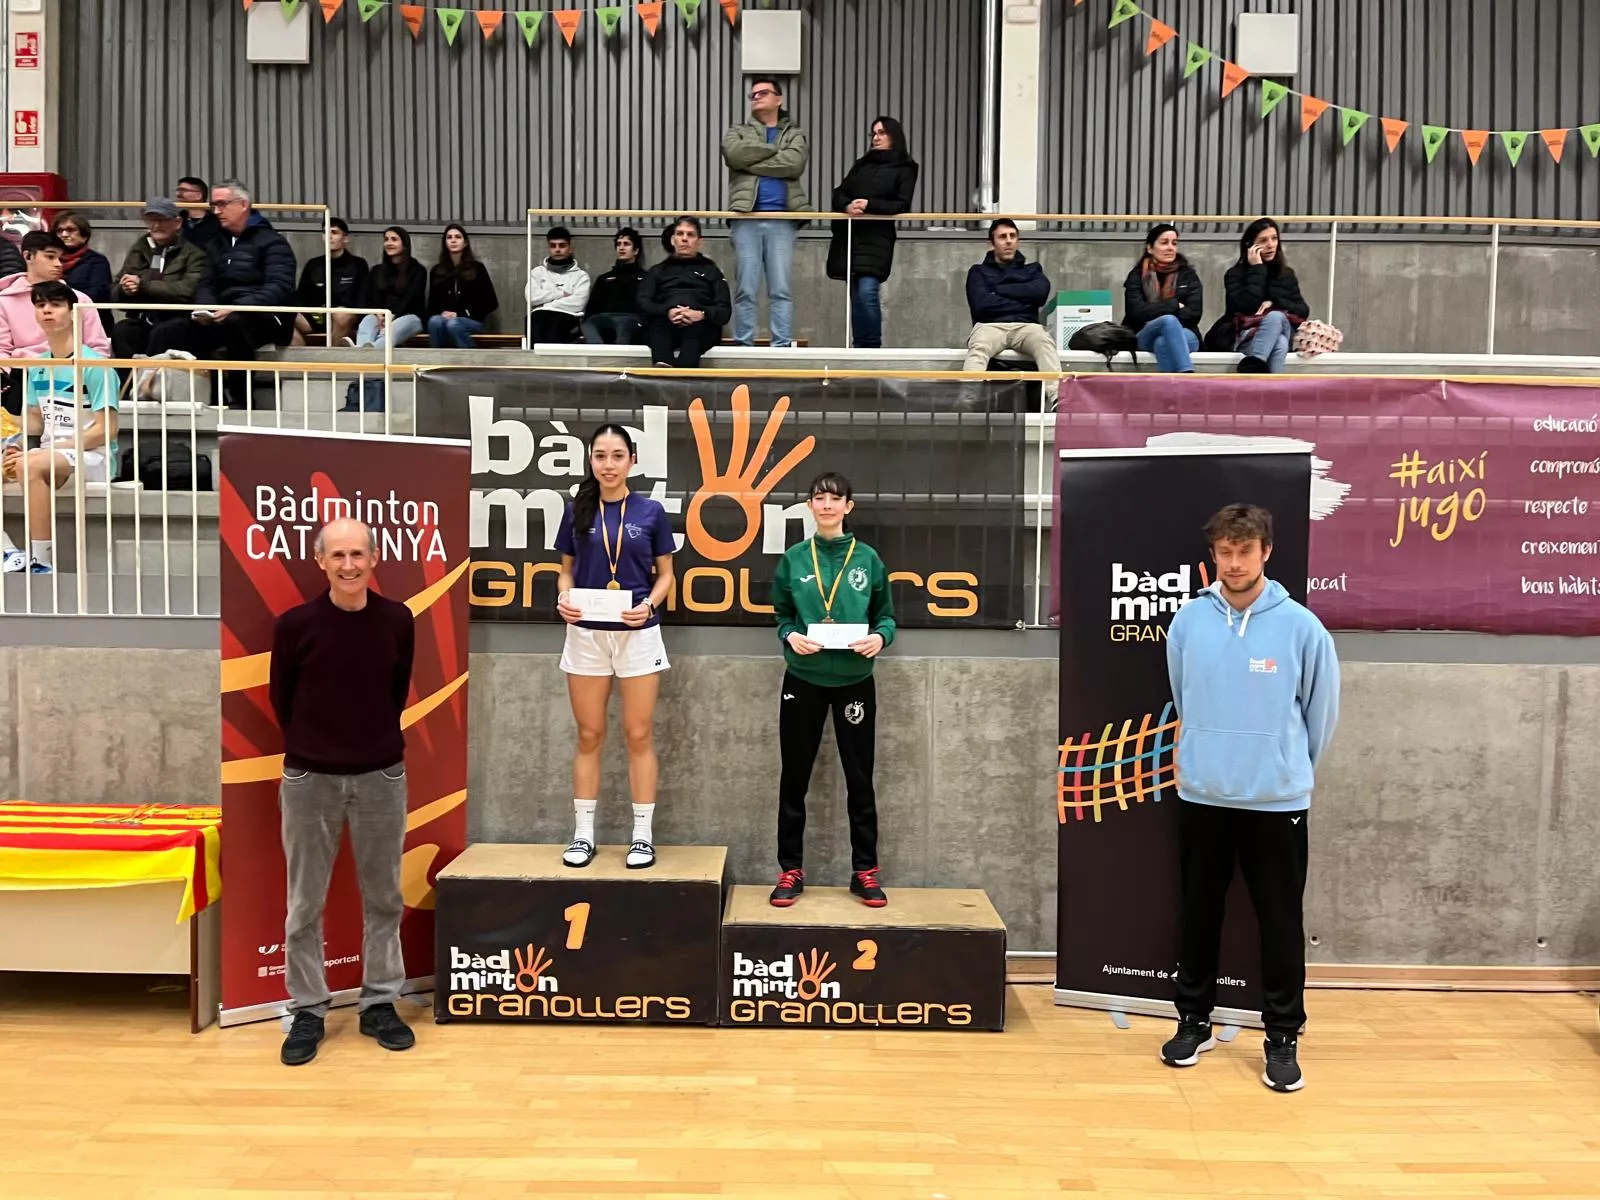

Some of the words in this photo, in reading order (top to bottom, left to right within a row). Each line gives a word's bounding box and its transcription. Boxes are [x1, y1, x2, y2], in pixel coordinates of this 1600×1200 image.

[468, 394, 668, 479] bàd
[1533, 413, 1598, 433] educació
[1388, 449, 1488, 489] #així
[255, 485, 439, 526] Bàdminton
[1389, 487, 1486, 548] jugo
[1524, 496, 1588, 520] respecte
[1111, 562, 1191, 593] bàd
[1521, 575, 1555, 594] bons
[564, 902, 591, 950] 1
[323, 954, 360, 968] sportcat
[450, 946, 510, 970] bàd
[733, 952, 794, 978] bàd
[852, 939, 878, 971] 2
[1102, 964, 1155, 978] Ajuntament
[1156, 970, 1169, 979] de
